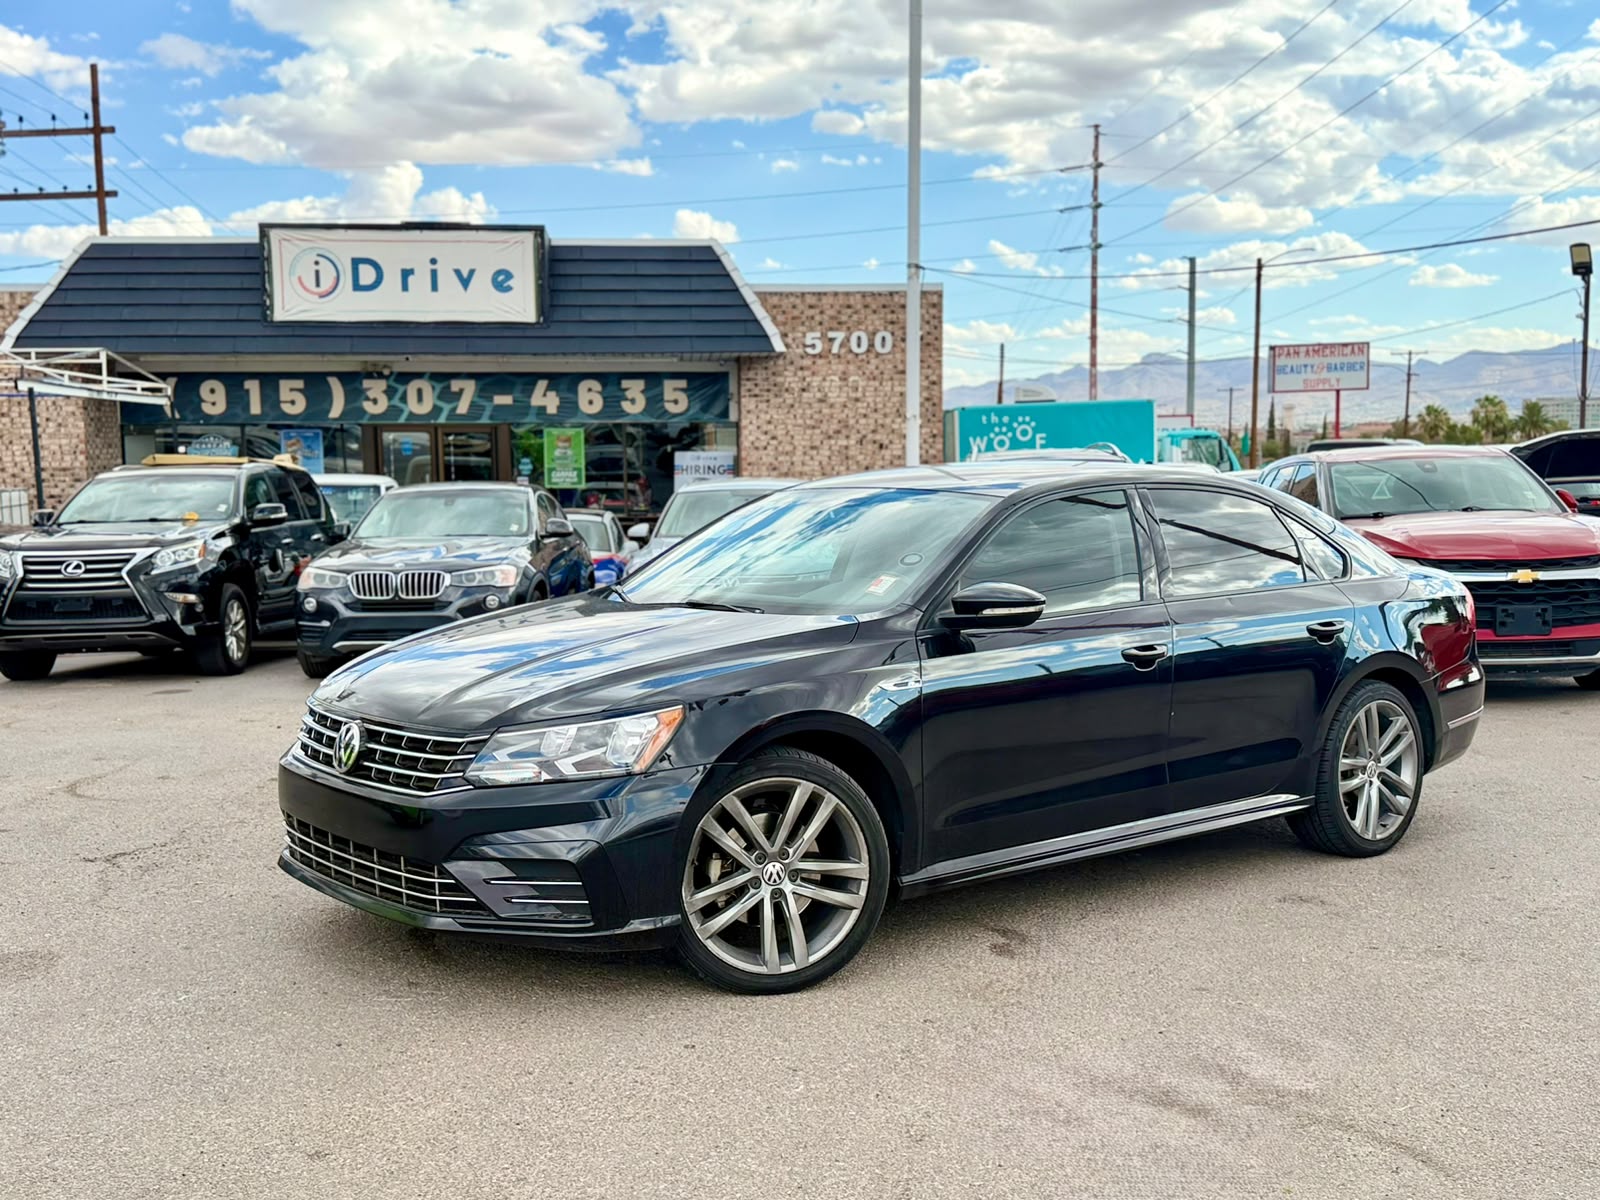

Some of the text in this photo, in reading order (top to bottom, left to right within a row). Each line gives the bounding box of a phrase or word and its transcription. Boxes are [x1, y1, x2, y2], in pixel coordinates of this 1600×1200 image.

[804, 331, 893, 354] 5700
[1277, 344, 1365, 359] PAN AMERICAN
[1277, 364, 1315, 375] BEAUTY
[1327, 361, 1366, 373] BARBER
[1303, 378, 1342, 389] SUPPLY
[980, 412, 1010, 424] the
[680, 464, 727, 476] HIRING
